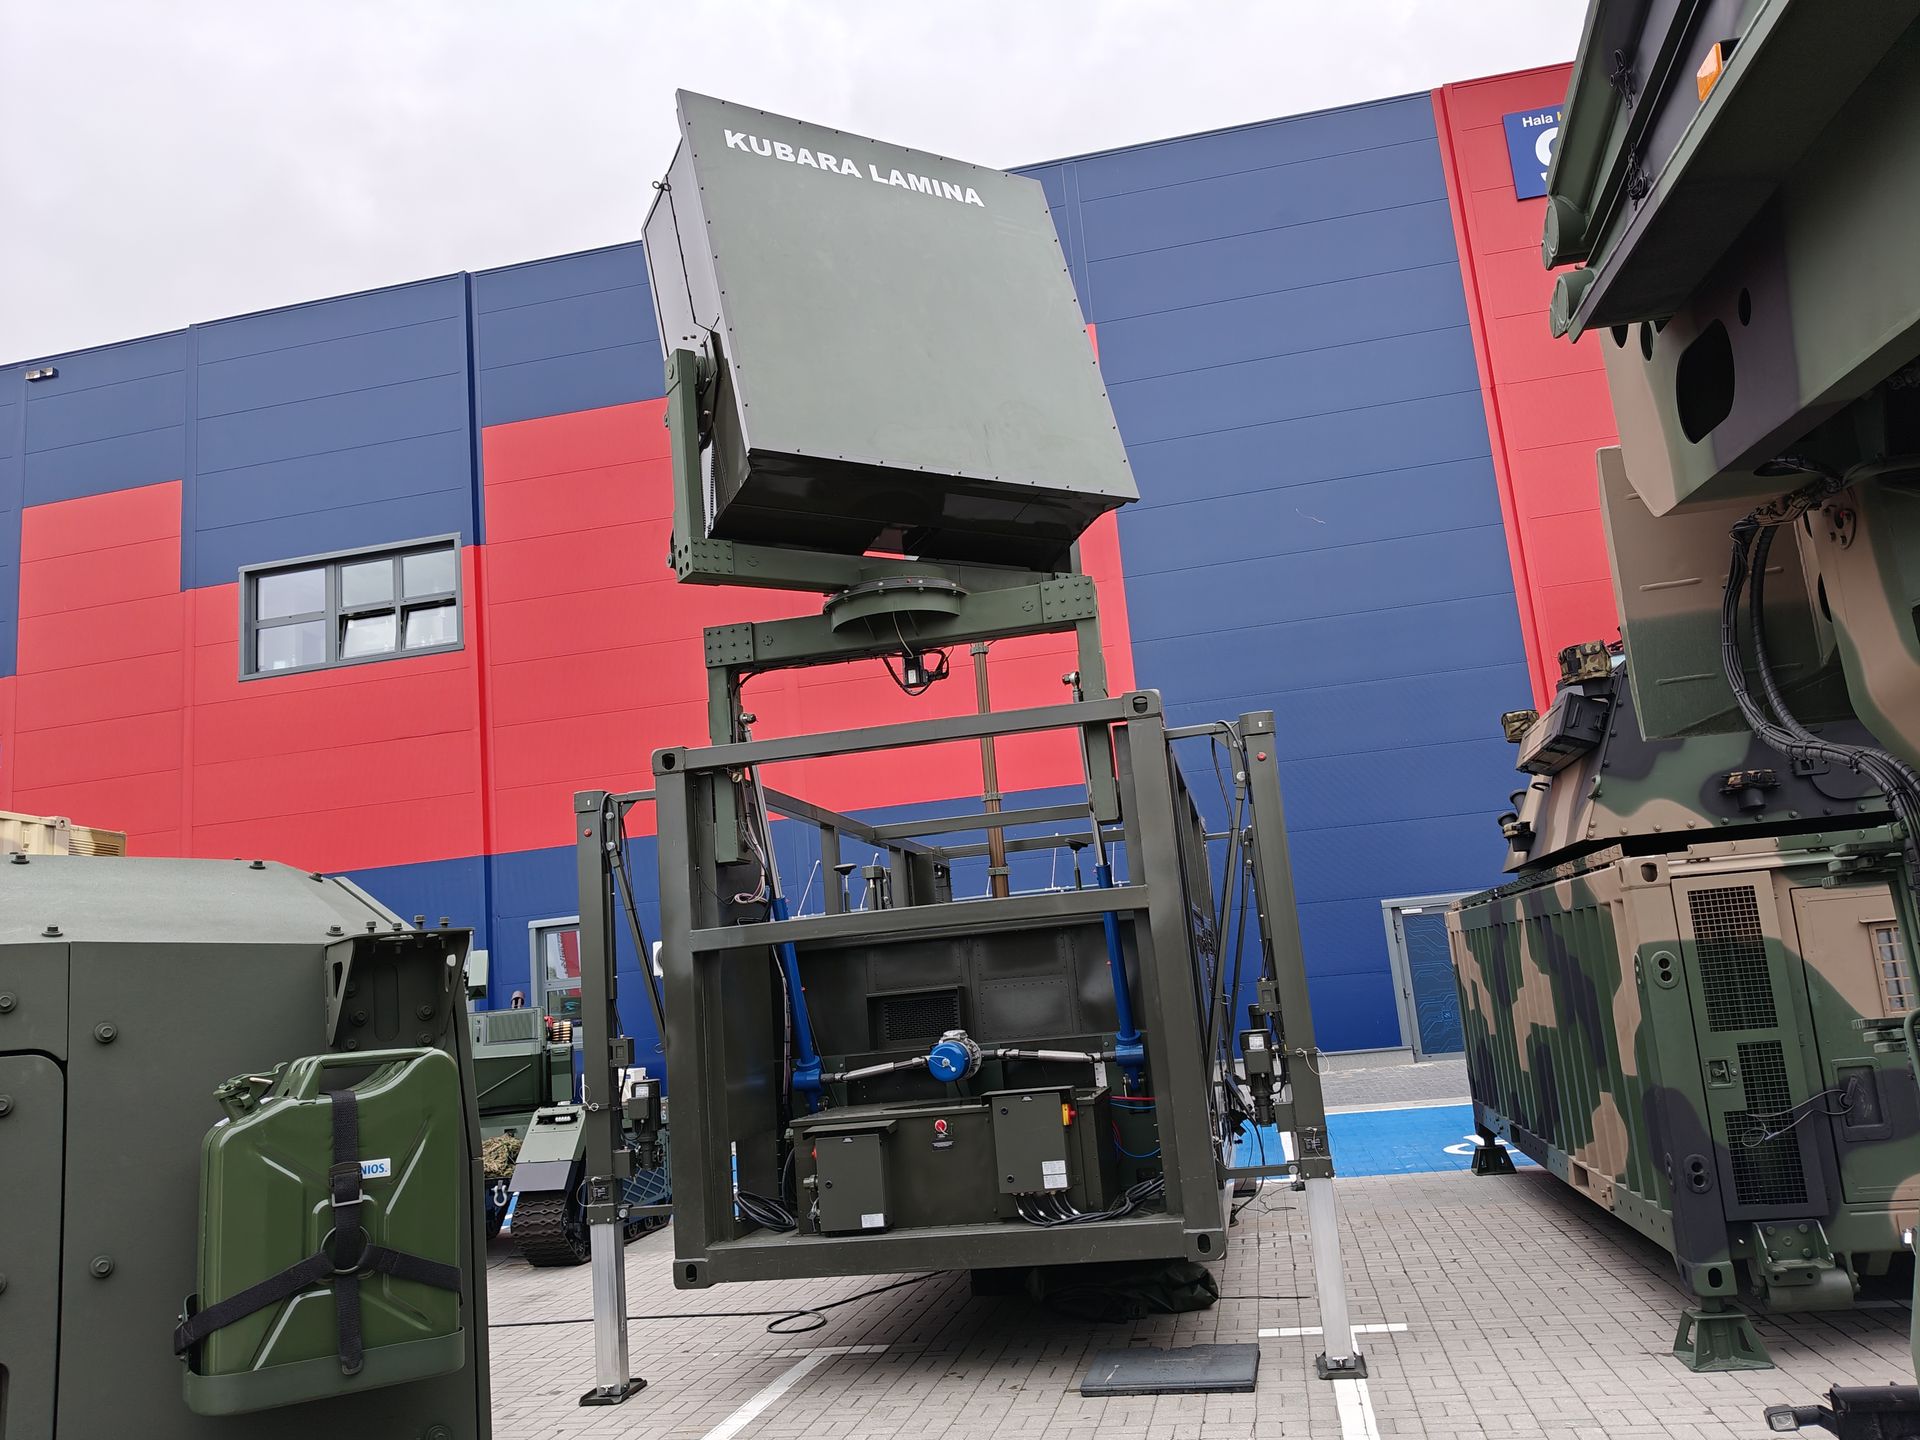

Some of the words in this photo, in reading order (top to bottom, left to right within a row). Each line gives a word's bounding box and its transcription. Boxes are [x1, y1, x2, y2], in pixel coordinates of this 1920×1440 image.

[1522, 114, 1554, 128] Hala
[723, 129, 863, 179] KUBARA
[868, 164, 985, 207] LAMINA
